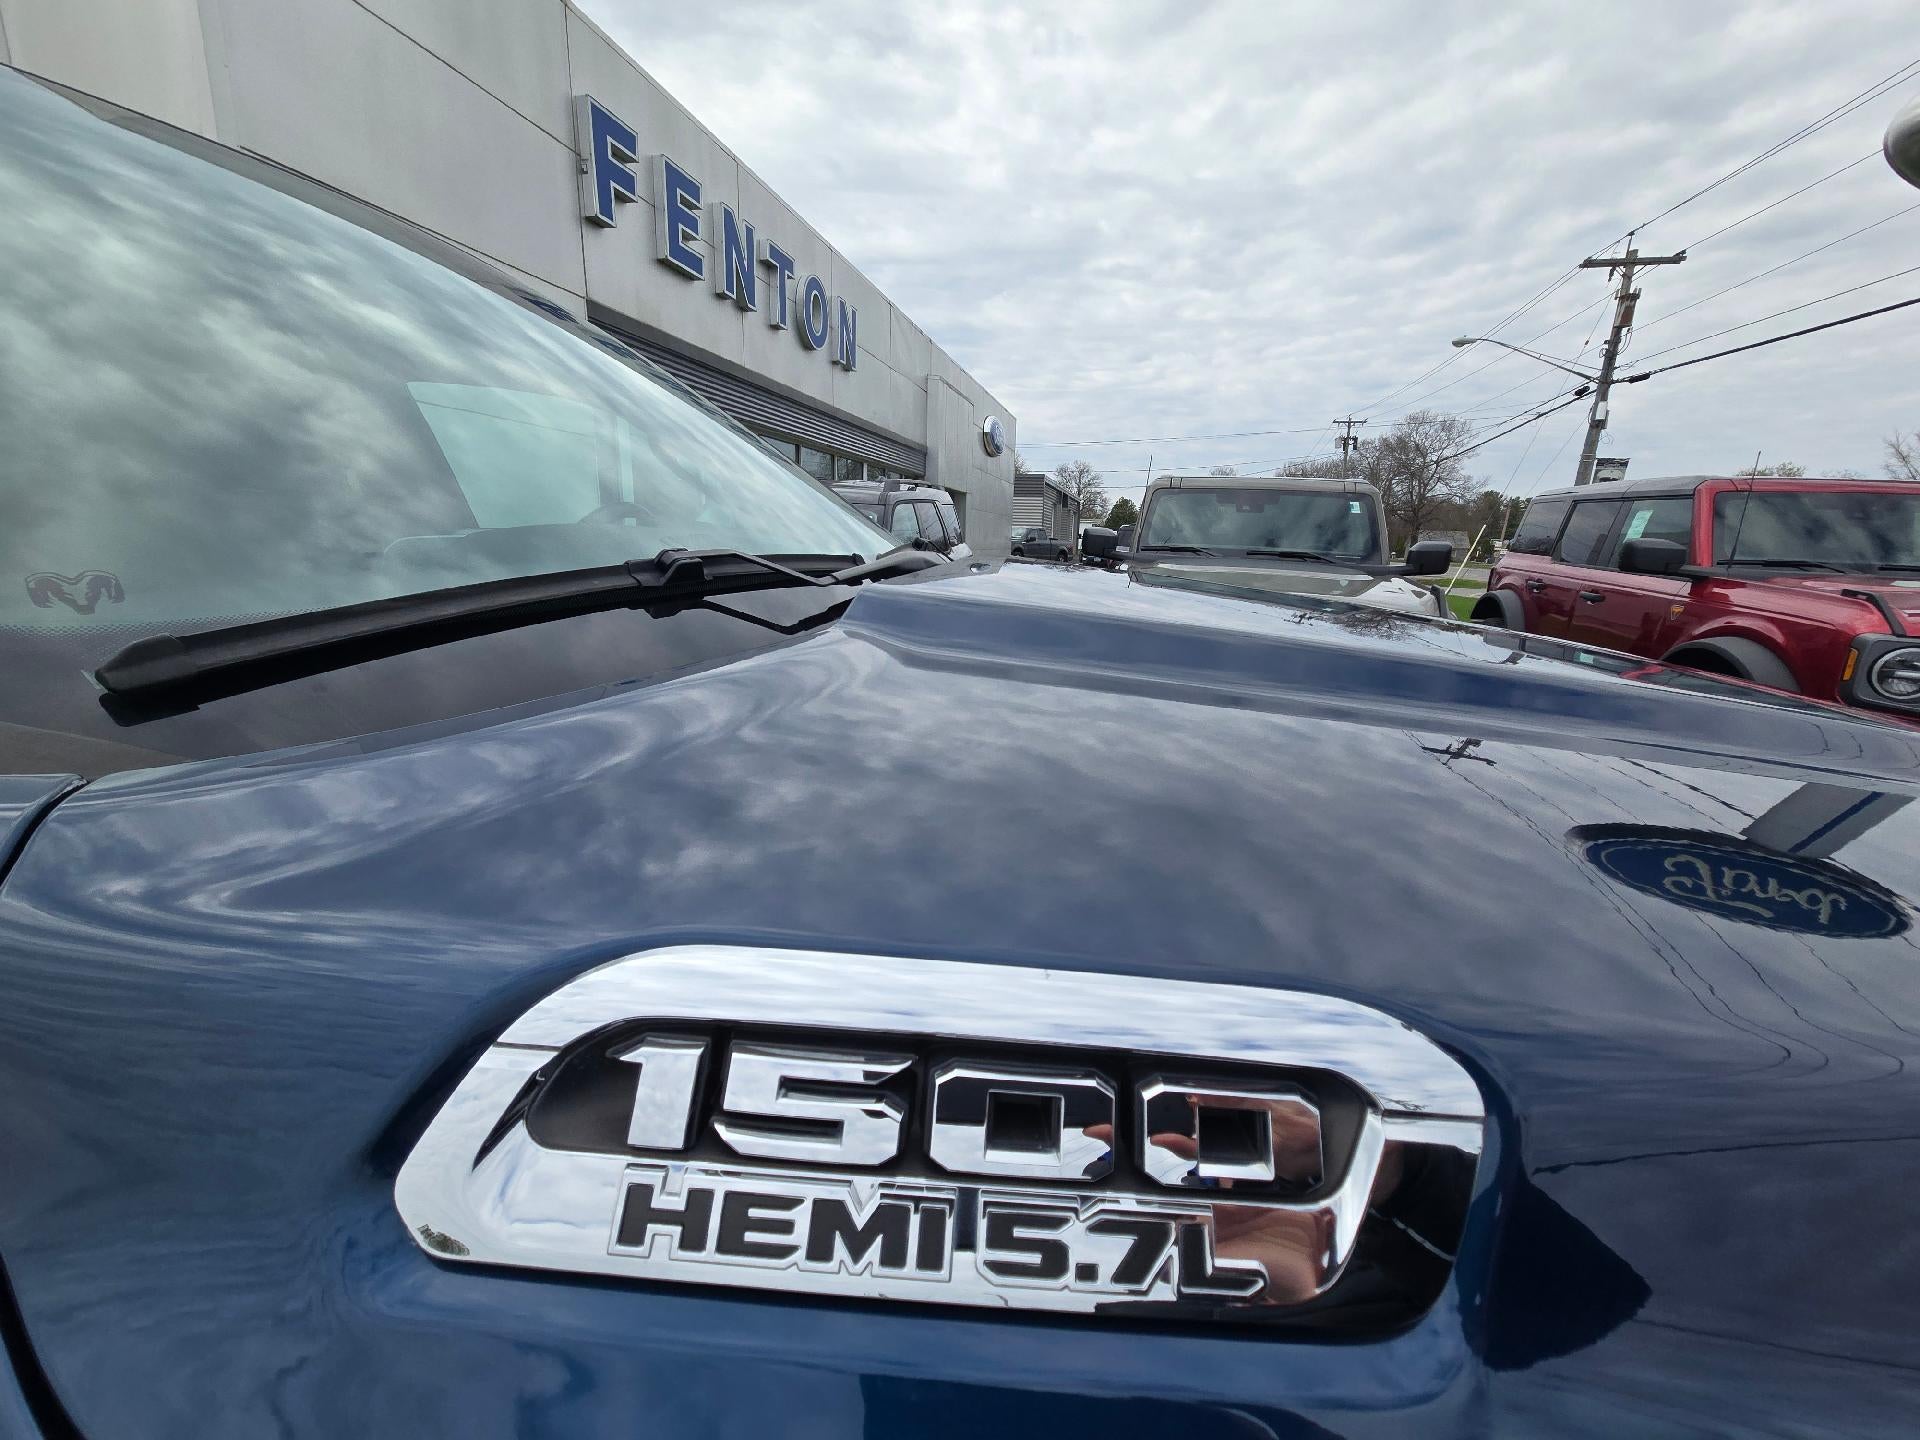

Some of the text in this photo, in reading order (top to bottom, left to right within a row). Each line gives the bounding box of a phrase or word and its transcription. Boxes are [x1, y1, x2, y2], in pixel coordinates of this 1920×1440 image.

[578, 94, 857, 371] FENTON
[607, 1035, 1325, 1192] 1500
[614, 1181, 1267, 1295] HEMI 5.7L
